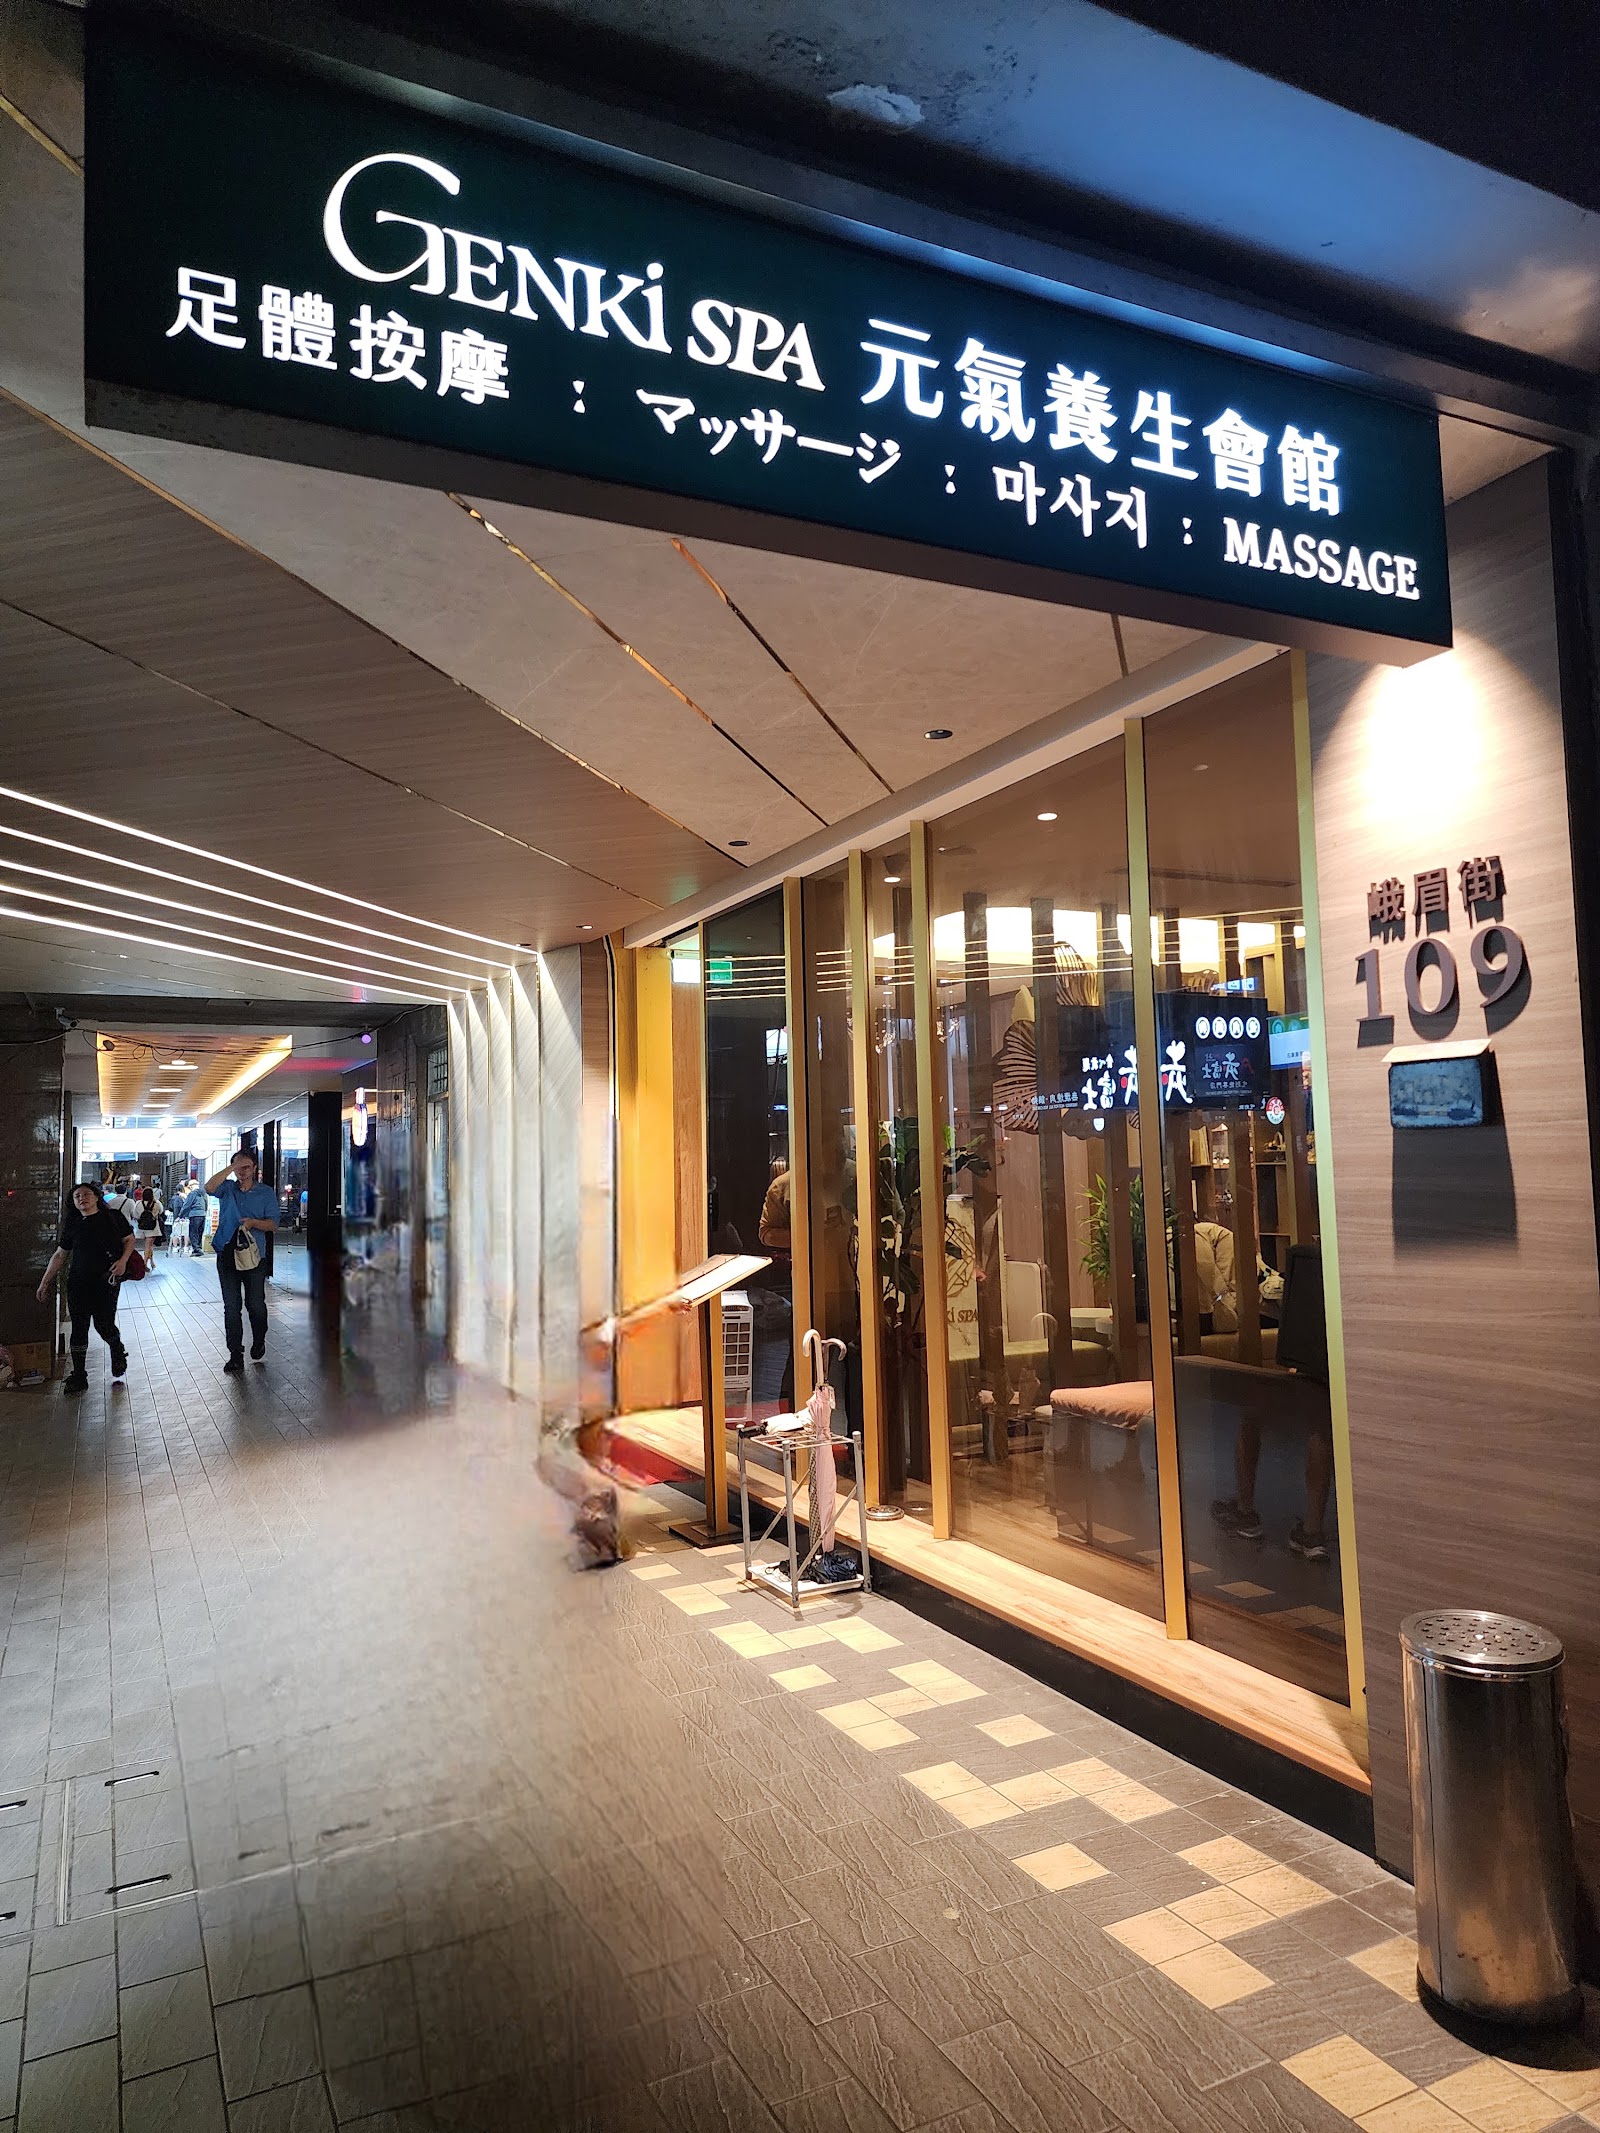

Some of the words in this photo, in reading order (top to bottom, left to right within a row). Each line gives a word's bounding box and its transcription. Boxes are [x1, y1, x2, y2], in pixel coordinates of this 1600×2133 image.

[165, 266, 511, 405] 足體按摩
[636, 389, 903, 483] マッサージ
[992, 461, 1148, 549] 마사지
[1223, 517, 1421, 601] MASSAGE
[686, 299, 826, 391] SPA
[860, 318, 1341, 517] 元氣養生會館
[1367, 855, 1503, 923] 峨眉街
[1355, 925, 1523, 1023] 109
[957, 1308, 978, 1323] SPA
